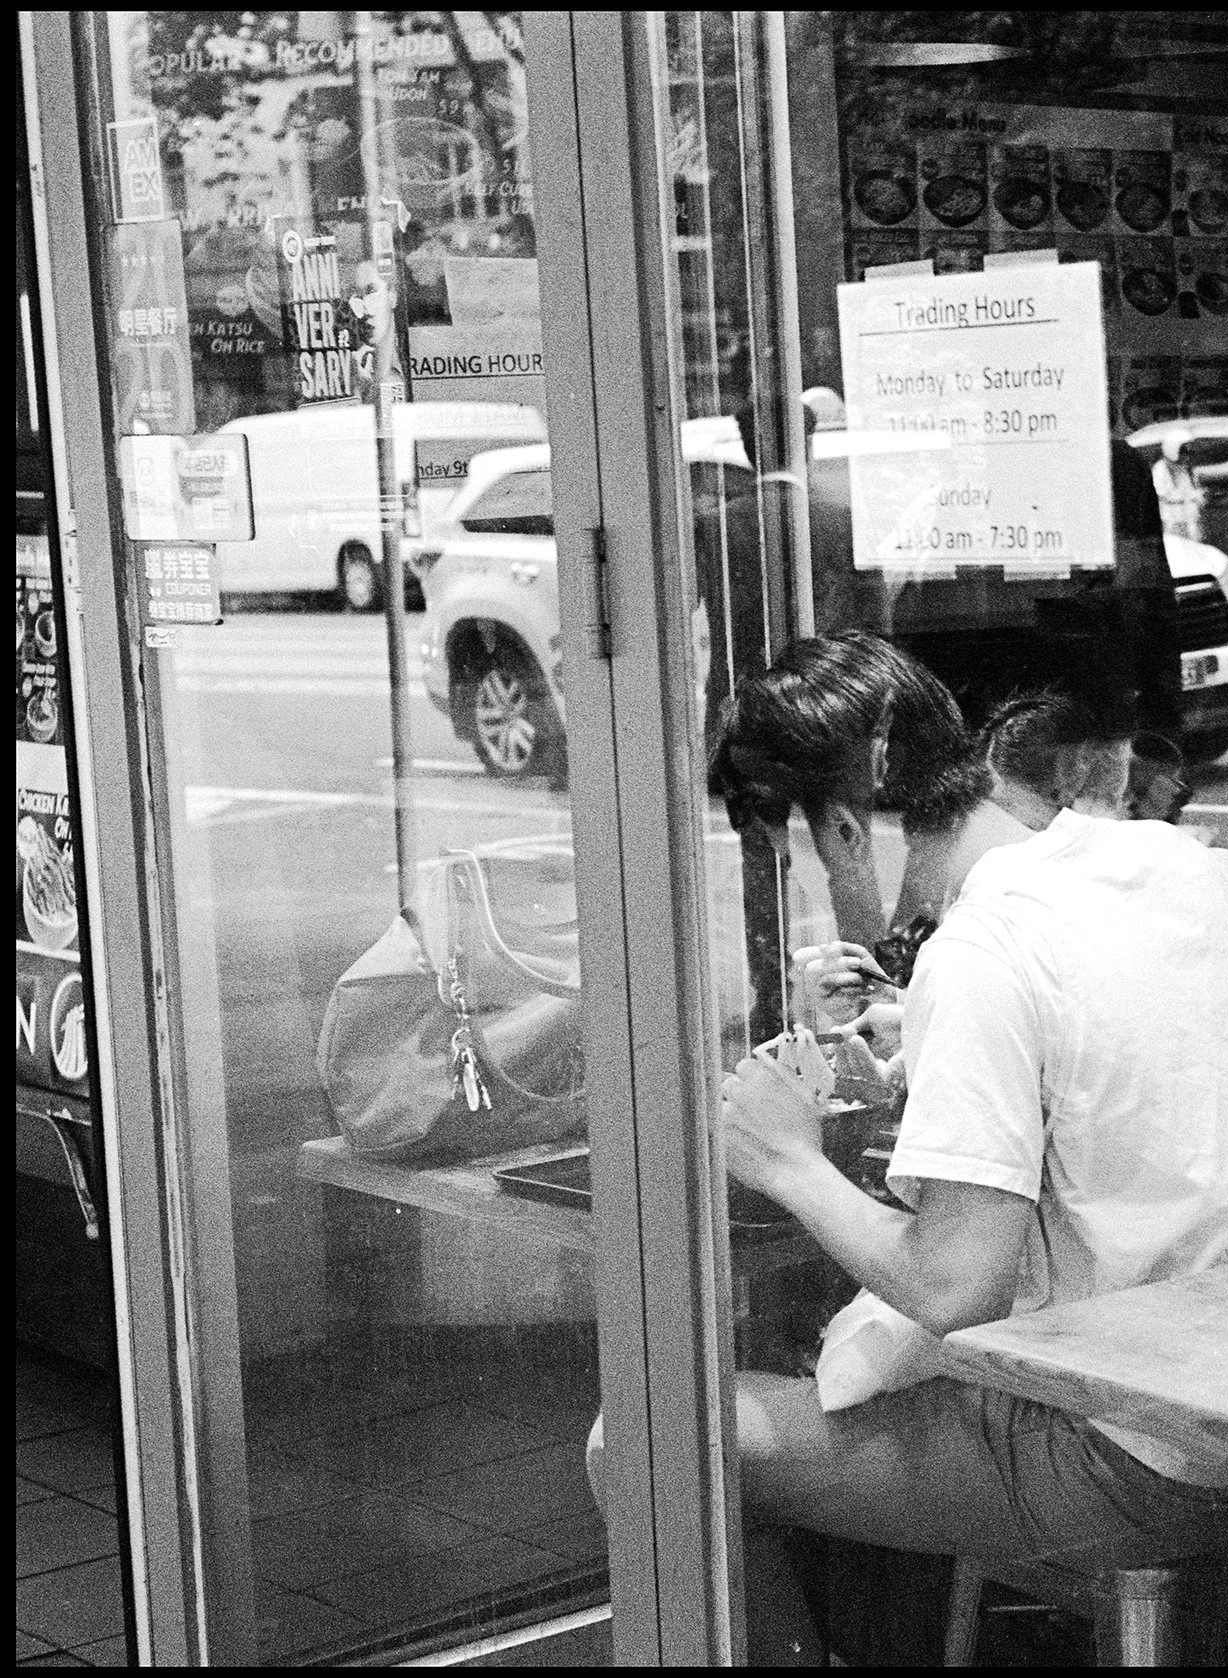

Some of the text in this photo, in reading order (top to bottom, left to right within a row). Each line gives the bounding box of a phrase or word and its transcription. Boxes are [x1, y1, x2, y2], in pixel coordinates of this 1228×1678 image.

[149, 50, 241, 76] OPULAR
[125, 139, 157, 171] AM
[129, 171, 160, 202] EX
[894, 294, 1037, 327] Trading Hours
[206, 321, 253, 336] KATSU
[294, 302, 337, 350] VER
[211, 338, 265, 354] ON RICE
[299, 348, 352, 399] SARY
[410, 353, 543, 376] RADING HOUR
[876, 362, 1065, 397] Monday to Saturday
[983, 409, 1021, 434] 8:30
[1028, 412, 1058, 438] pm
[415, 459, 469, 477] nday 9t
[932, 482, 992, 510] unday
[946, 531, 973, 549] am
[990, 525, 1028, 549] 7:30
[1033, 529, 1063, 554] pm
[165, 581, 212, 597] COUPONER
[18, 789, 55, 815] CHICKEN
